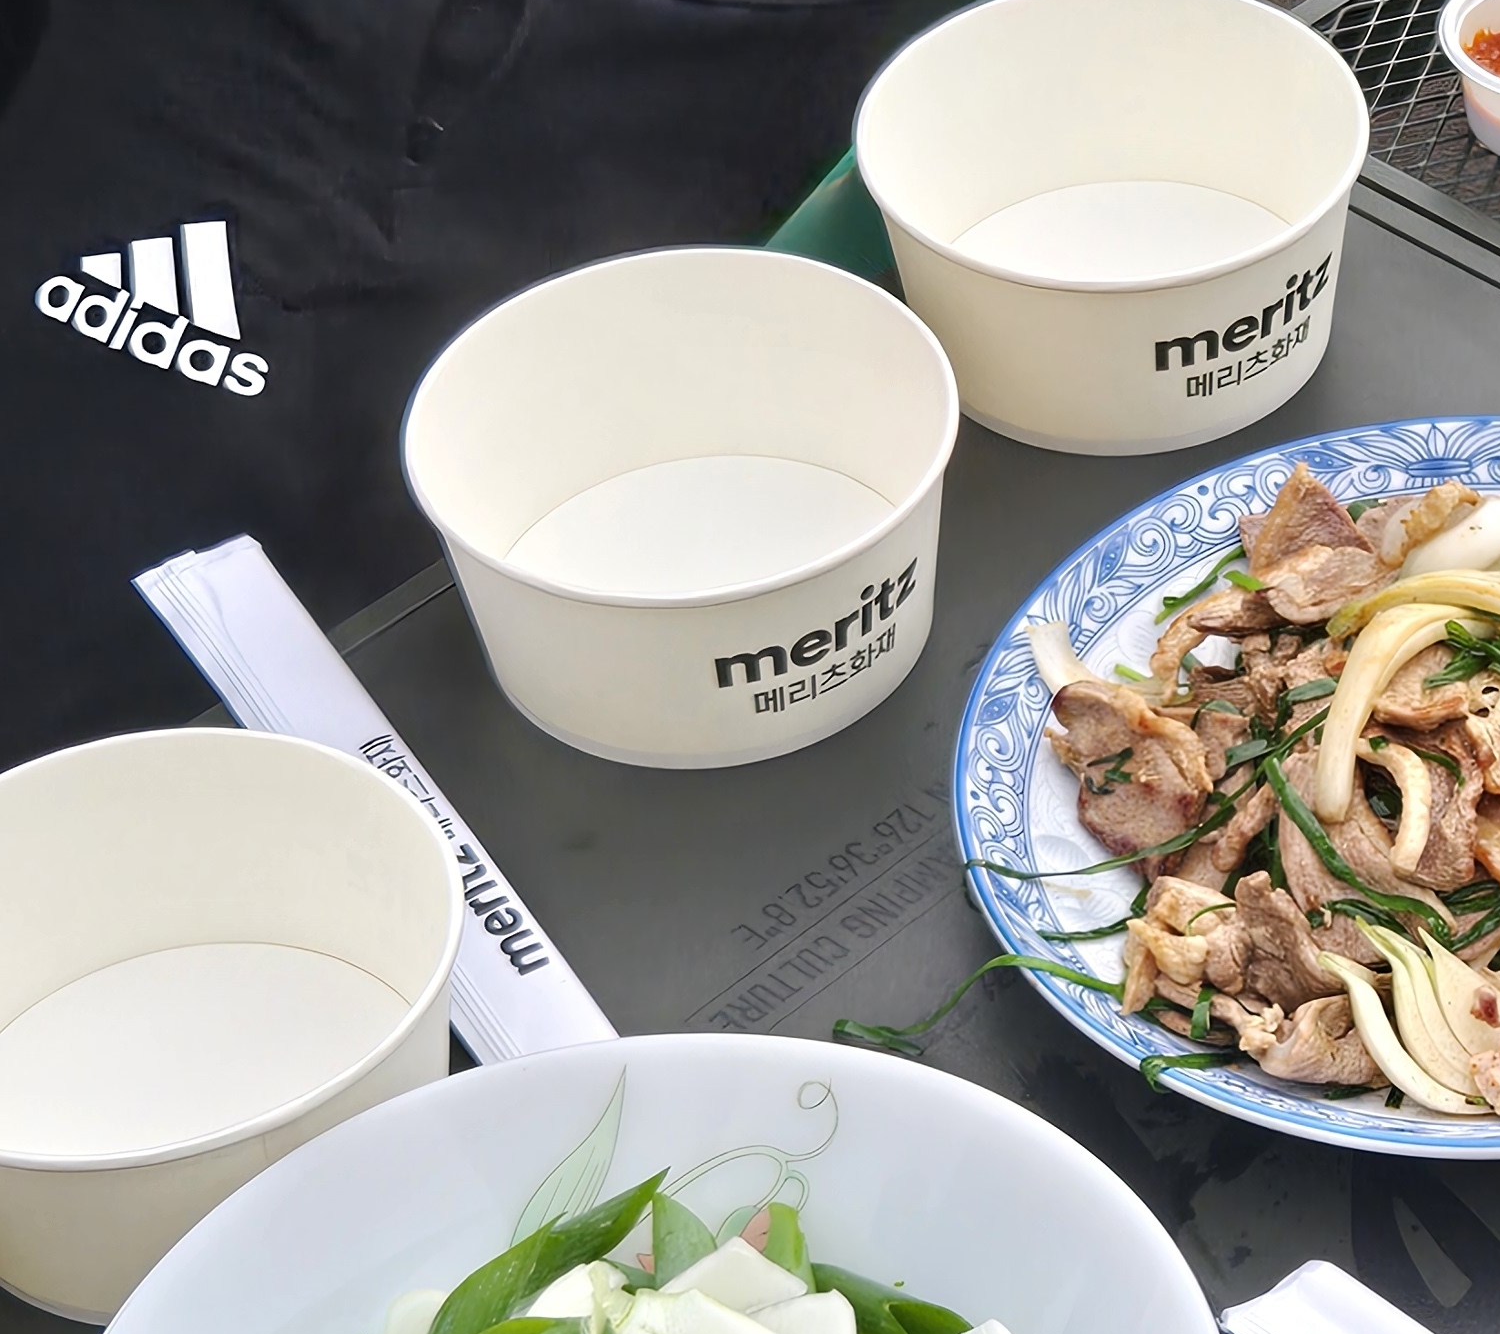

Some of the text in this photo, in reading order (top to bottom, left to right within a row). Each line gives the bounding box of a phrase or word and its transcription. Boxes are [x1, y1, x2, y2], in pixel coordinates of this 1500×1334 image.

[34, 275, 270, 397] adidas
[1155, 251, 1333, 372] meritz
[1186, 315, 1311, 399] 메리츠화재
[714, 557, 918, 689] meritz
[753, 623, 896, 716] 메리츠화재
